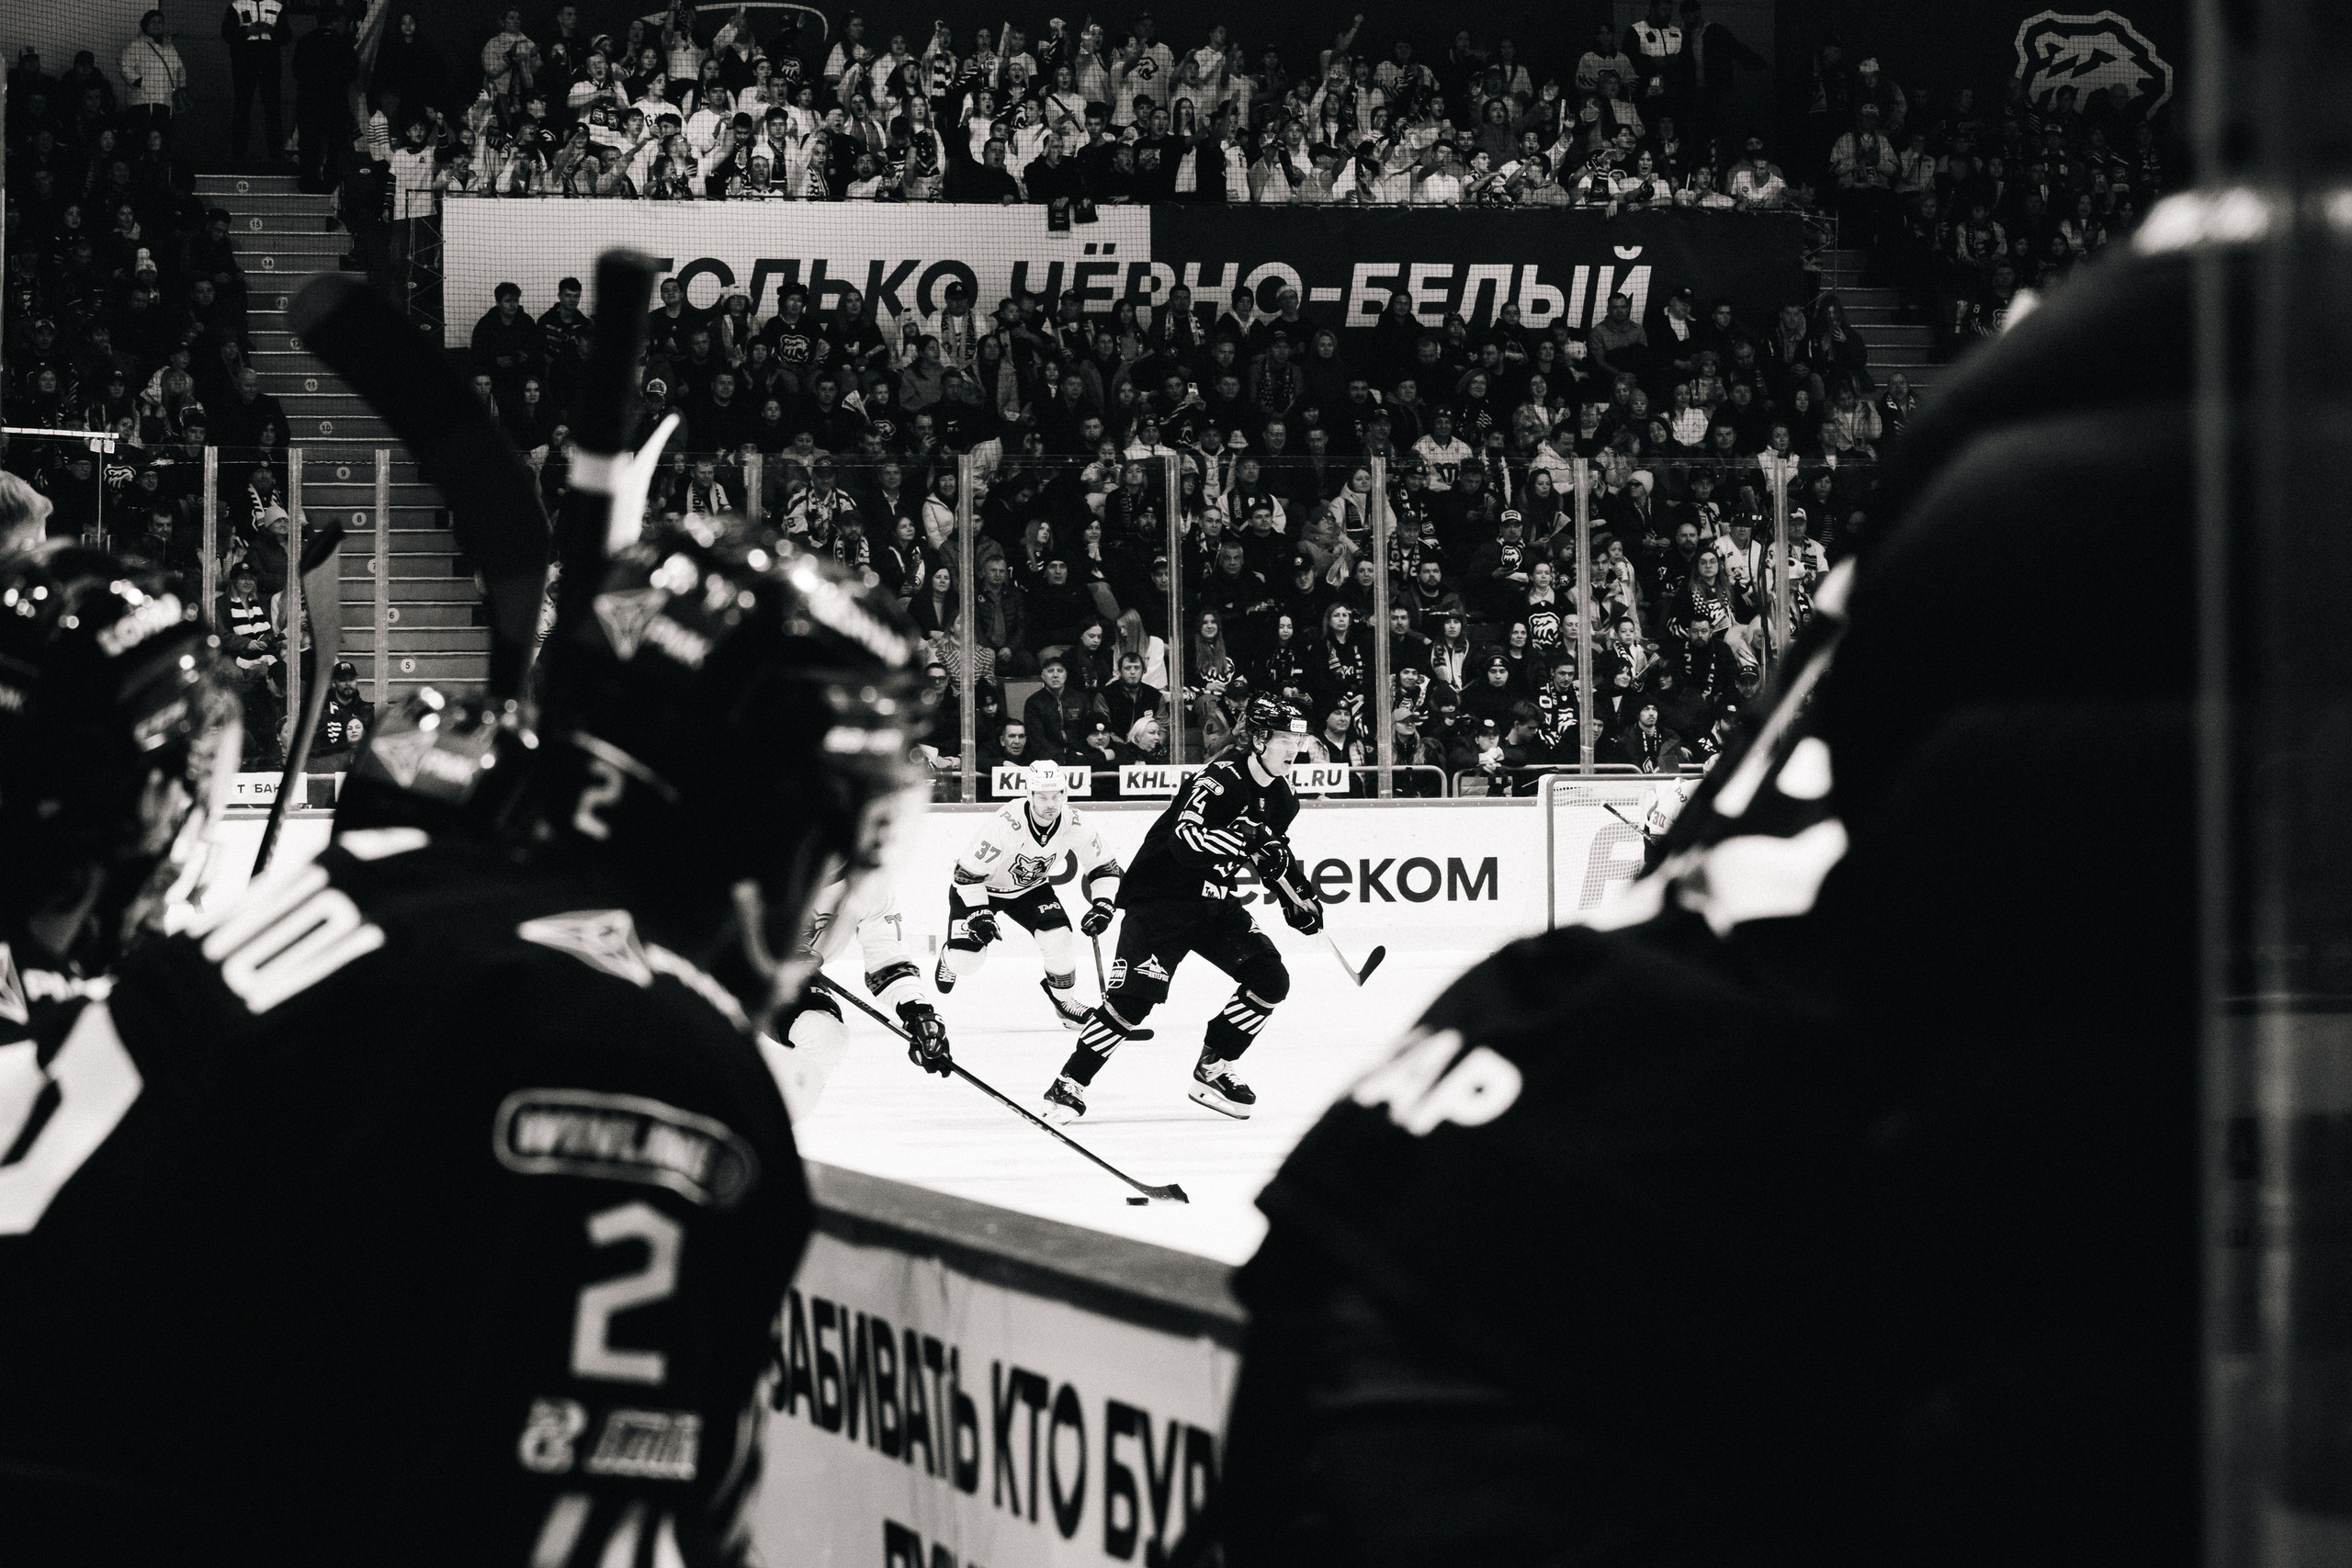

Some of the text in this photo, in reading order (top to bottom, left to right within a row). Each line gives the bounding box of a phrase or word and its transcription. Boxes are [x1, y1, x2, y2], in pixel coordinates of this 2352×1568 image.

[251, 220, 262, 229] 15
[263, 259, 274, 267] 14
[307, 381, 316, 389] 11
[321, 423, 332, 432] 10
[389, 611, 394, 619] 6
[405, 661, 411, 670] 5
[1044, 771, 1054, 779] 37
[1292, 770, 1342, 787] L.RU
[1000, 772, 1084, 789] KHU
[1126, 772, 1192, 789] KHL.R
[254, 784, 279, 794] БАН
[975, 840, 1001, 863] 37
[571, 1200, 683, 1386] 2
[991, 1359, 1088, 1541] КТО
